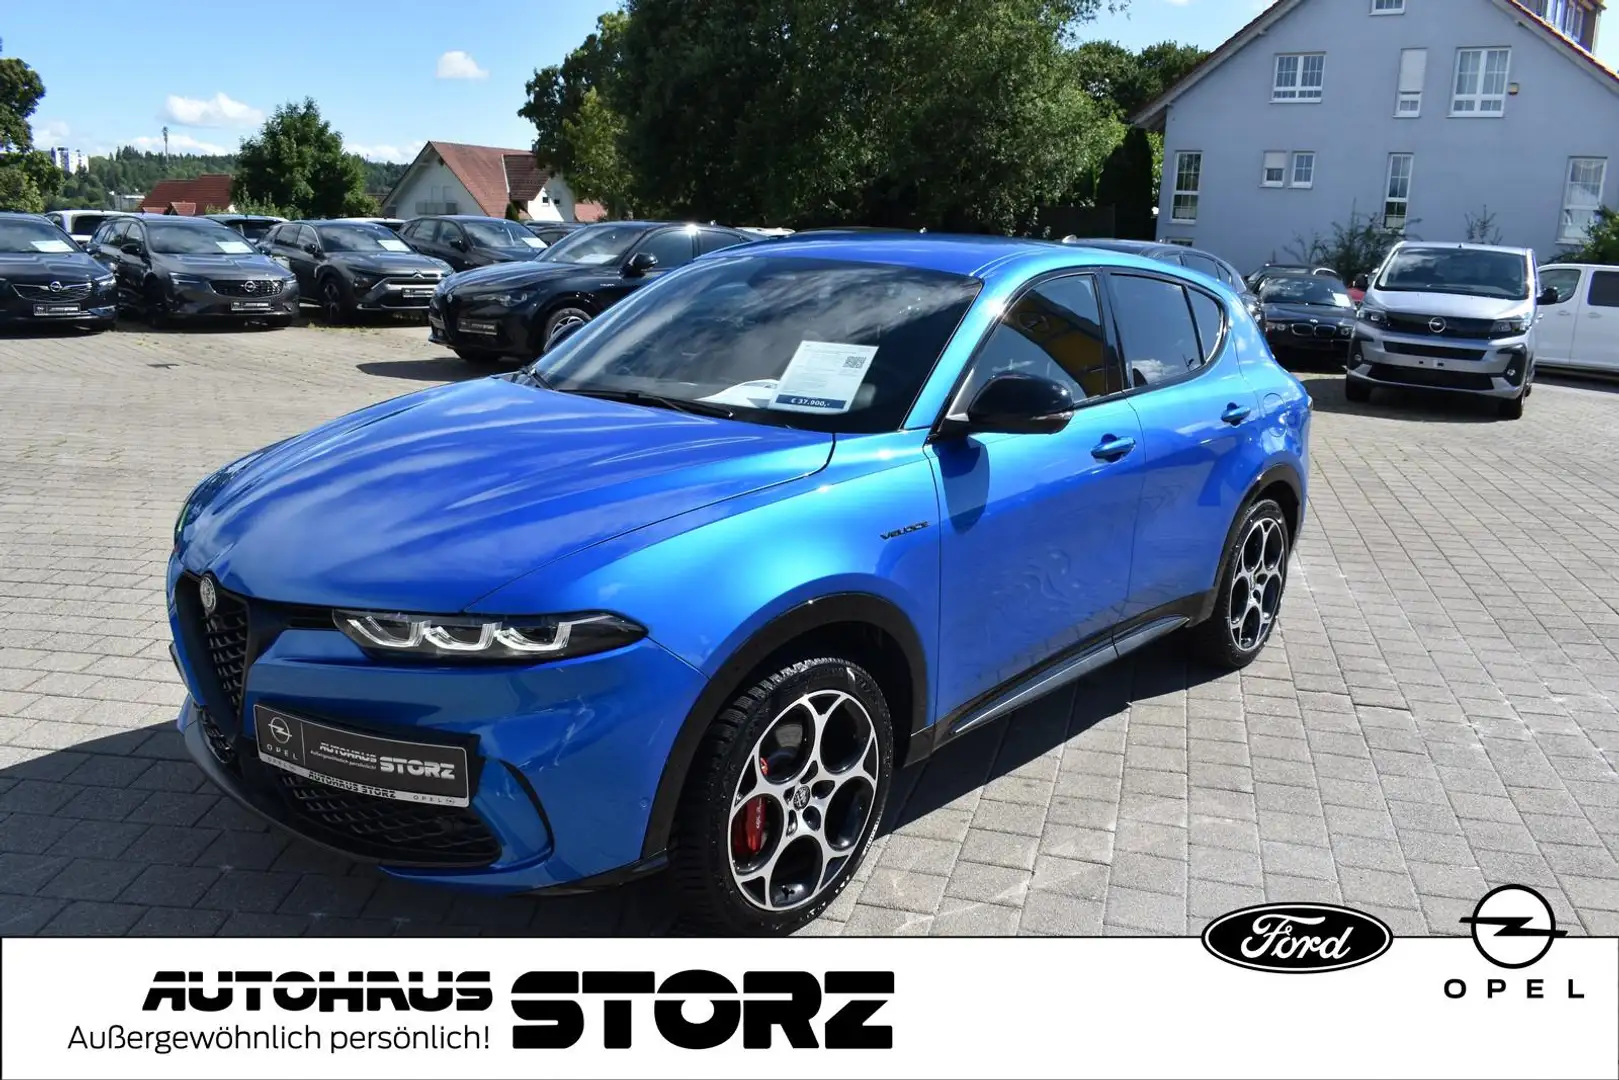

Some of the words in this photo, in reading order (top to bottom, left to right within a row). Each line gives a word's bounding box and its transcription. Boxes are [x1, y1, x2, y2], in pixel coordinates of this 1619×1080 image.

[880, 521, 929, 540] VELOCE
[320, 742, 377, 763] AUTOHAUS
[380, 756, 455, 780] STORZ
[308, 770, 359, 793] AUTOHAUS
[360, 784, 396, 799] STORZ
